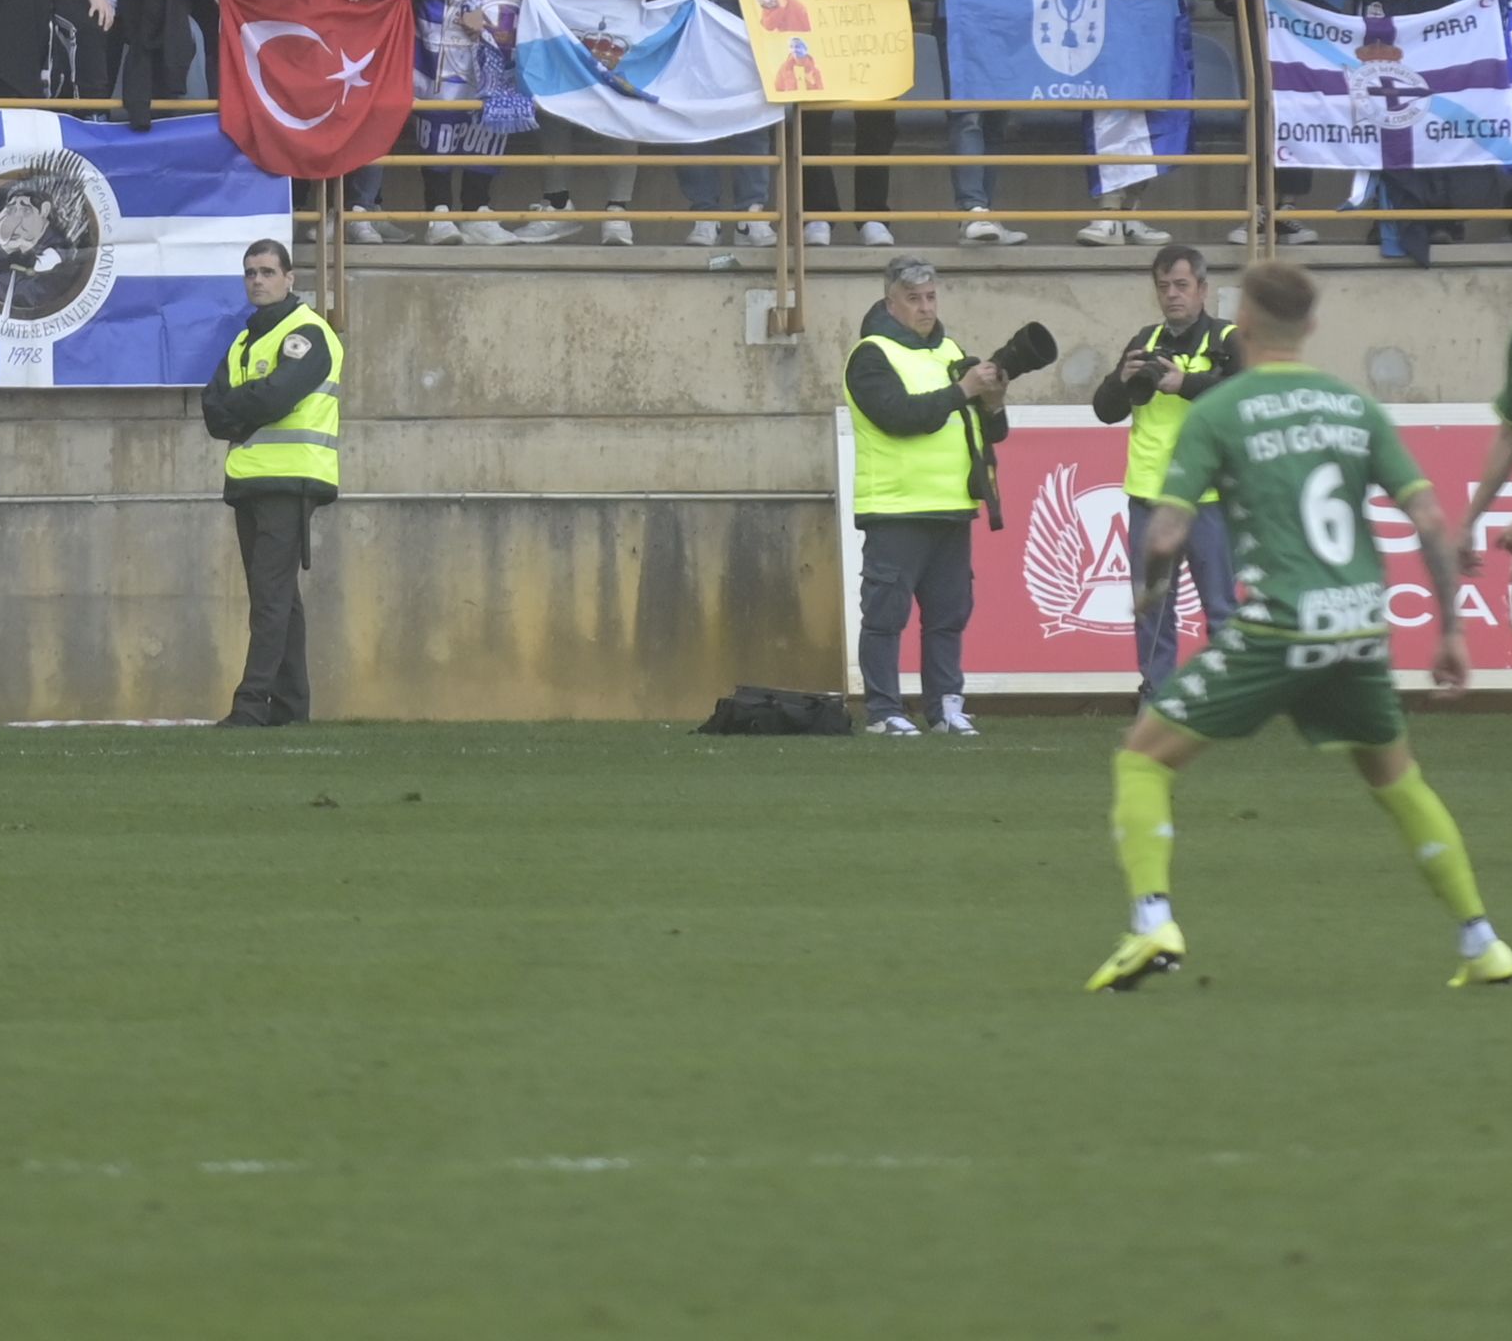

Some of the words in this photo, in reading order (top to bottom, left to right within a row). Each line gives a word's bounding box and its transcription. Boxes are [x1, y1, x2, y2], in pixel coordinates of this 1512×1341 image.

[1423, 15, 1477, 42] PARA
[1278, 122, 1379, 144] DOMINAR
[1426, 118, 1511, 143] GALICIA
[74, 243, 115, 320] LEVANTANDO
[7, 346, 44, 366] 1998
[1238, 388, 1365, 424] PELICANO
[1244, 429, 1287, 463] ISI
[1299, 461, 1355, 566] 6
